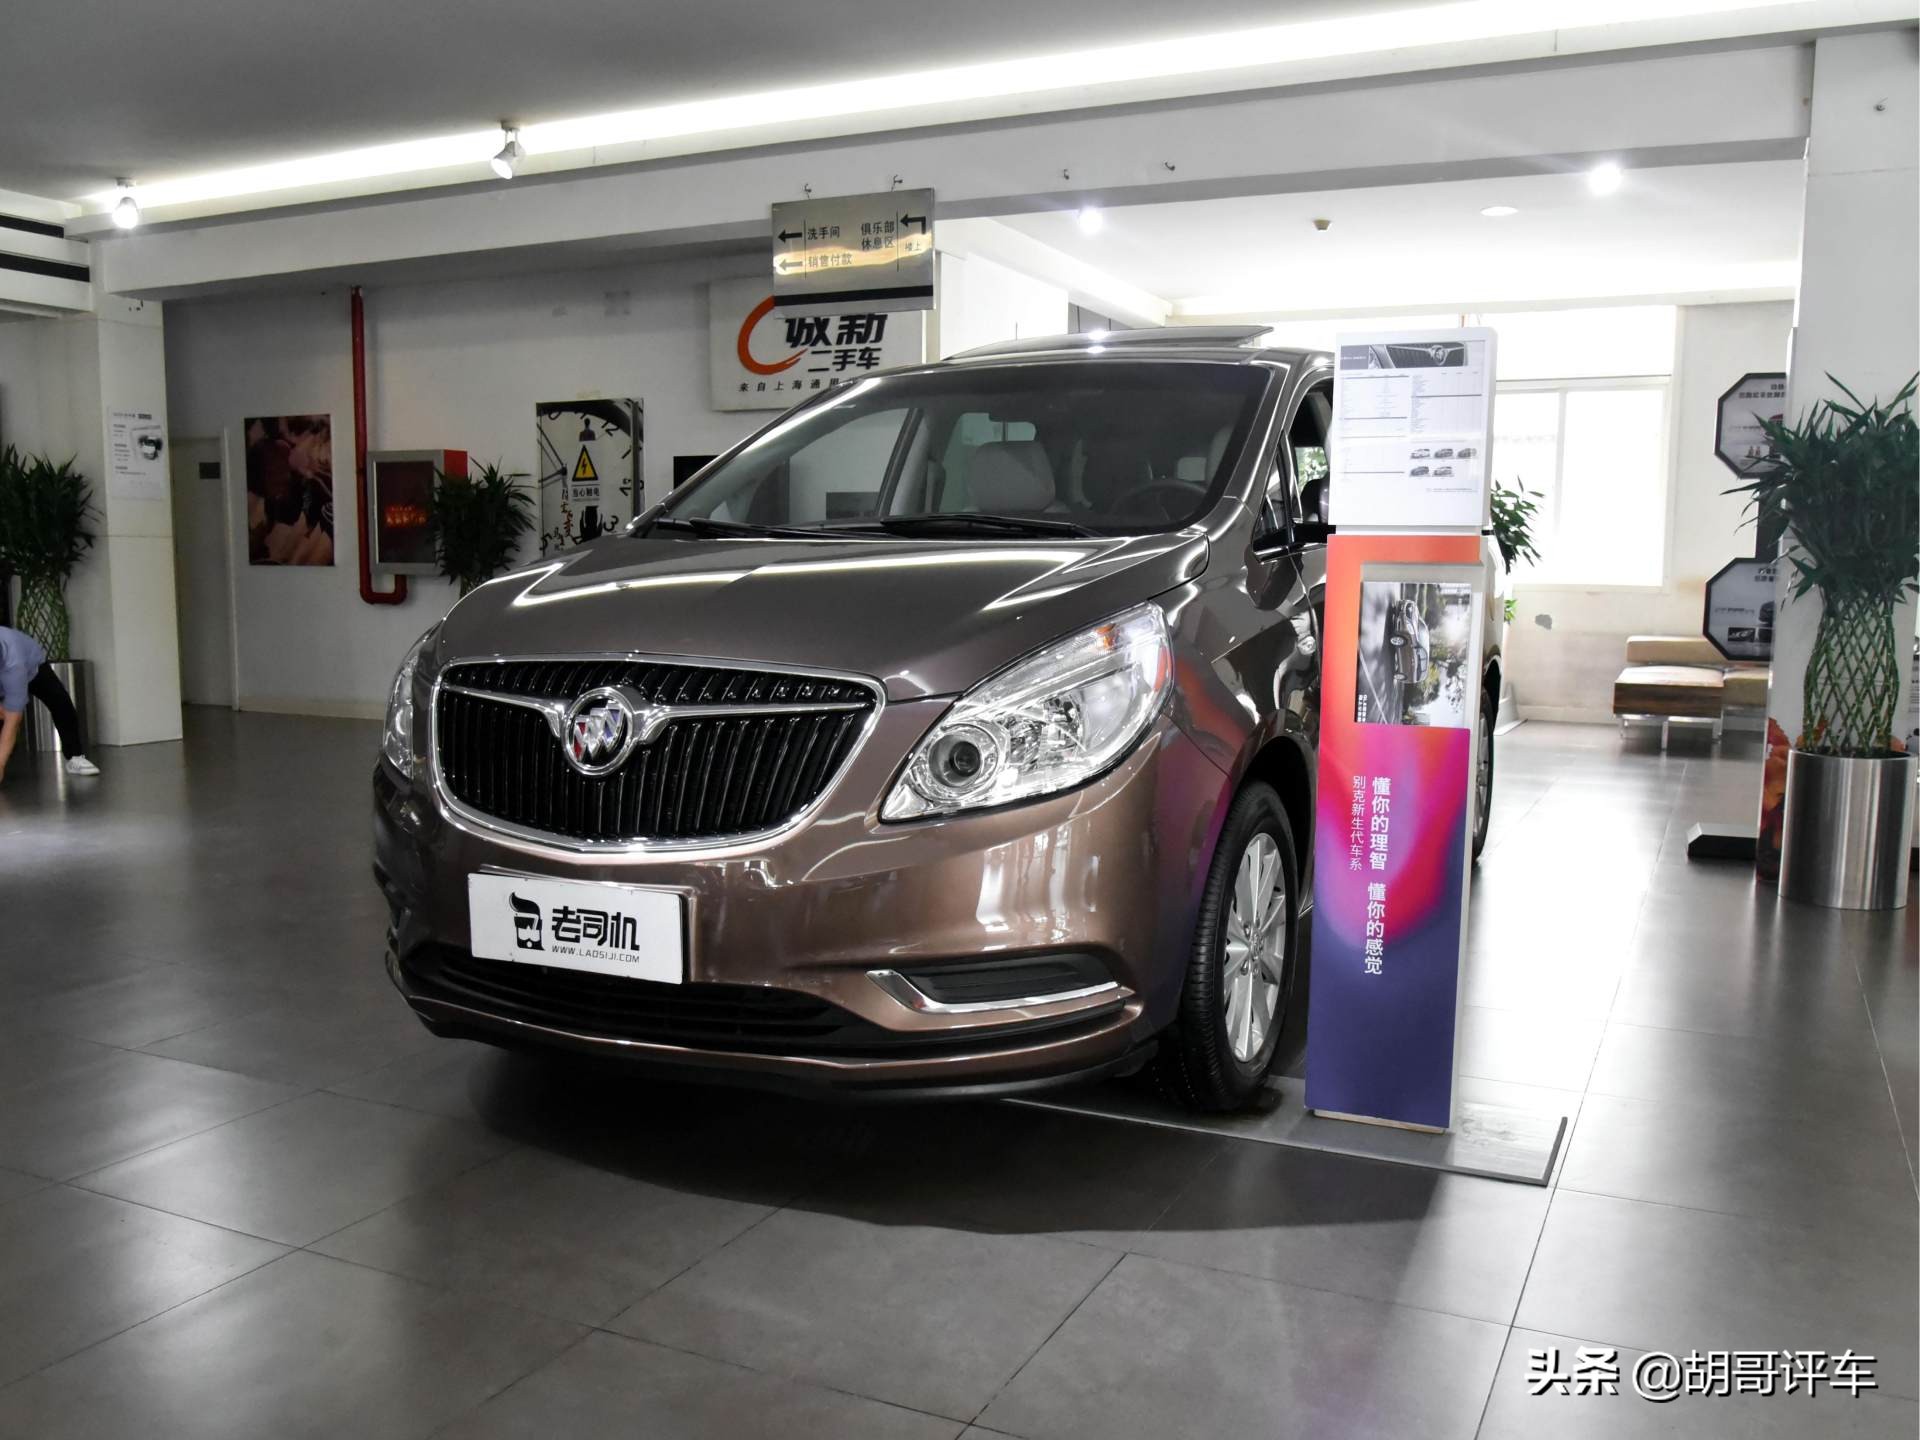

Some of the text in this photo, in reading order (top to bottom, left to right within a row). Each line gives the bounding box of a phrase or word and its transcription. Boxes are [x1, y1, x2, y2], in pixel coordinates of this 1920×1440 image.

[807, 226, 840, 240] 洗手间
[861, 221, 895, 234] 俱乐部
[861, 236, 894, 251] 休息区
[808, 253, 852, 268] 销售付款
[807, 347, 882, 372] 二手车
[572, 487, 600, 498] 当心触电
[1349, 776, 1365, 870] 别克新生代车系
[1364, 777, 1390, 974] 懂你的理智 懂你的感觉
[551, 905, 641, 951] 老司机
[551, 944, 640, 964] WWW.LAOSIJI.COM
